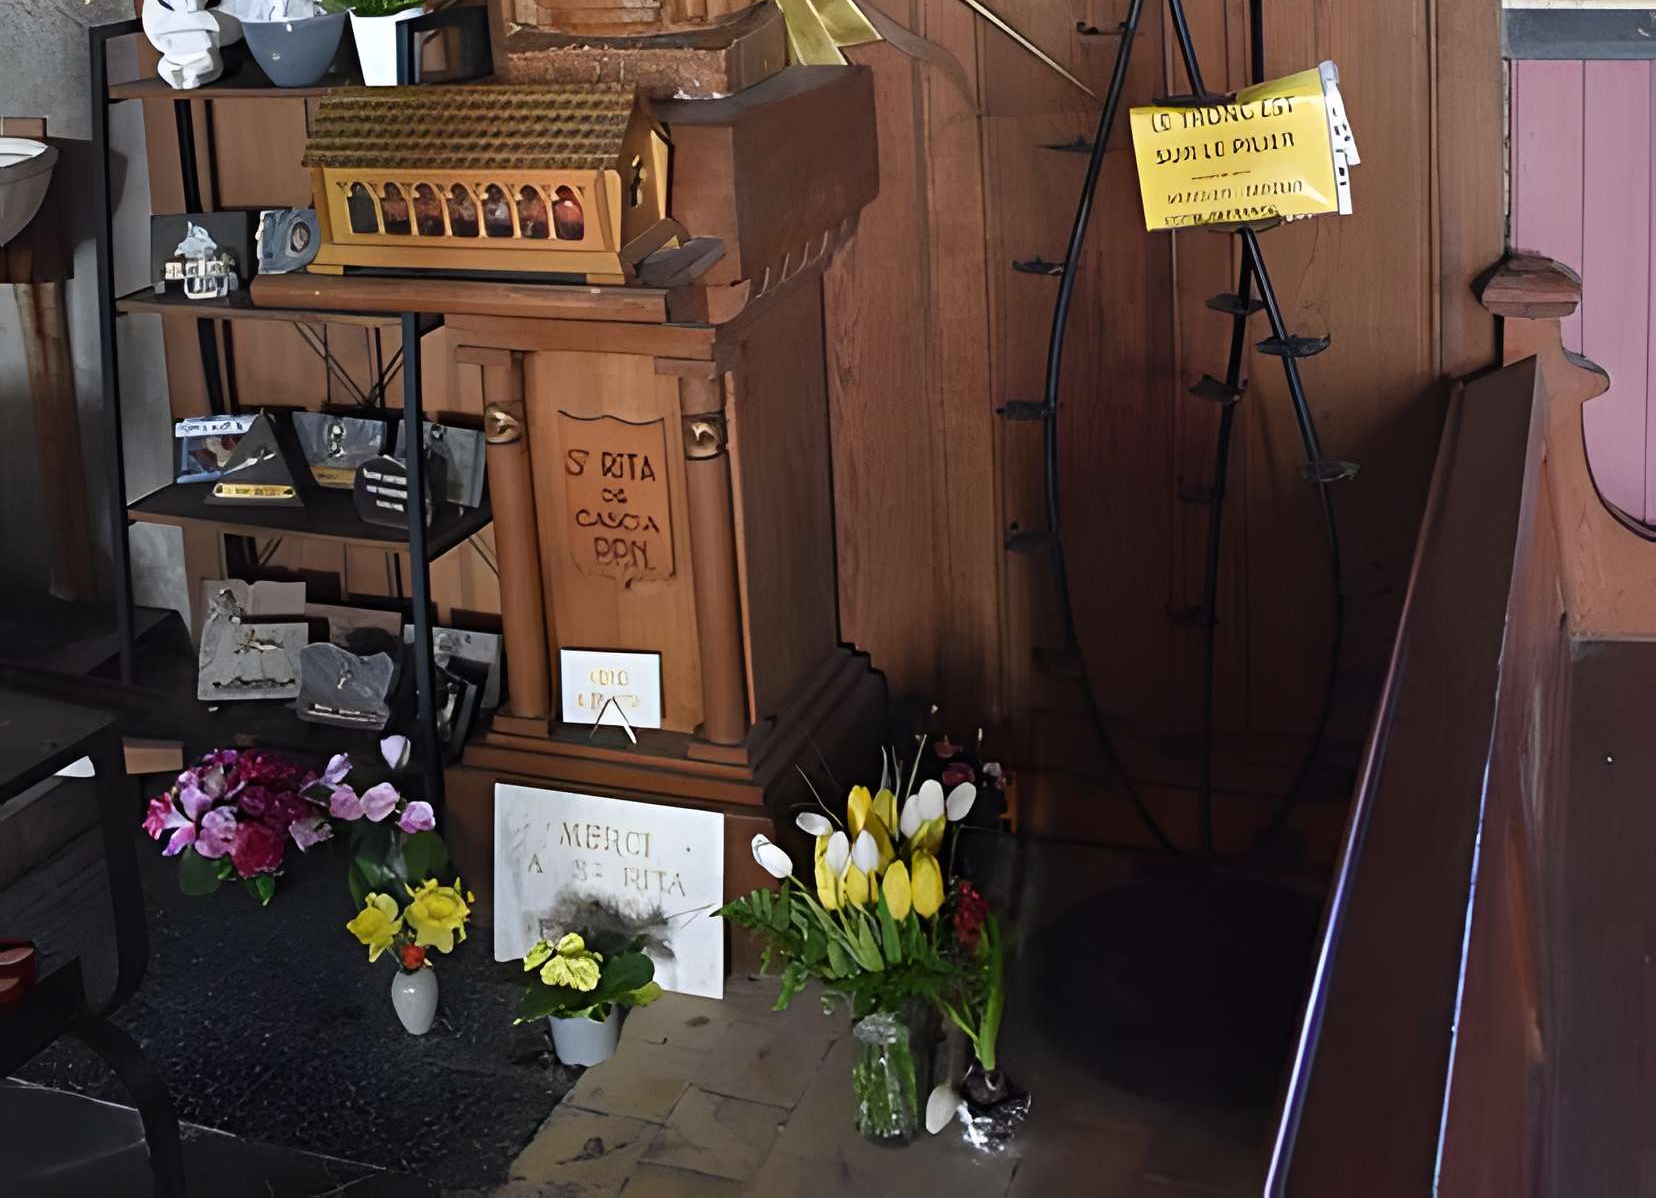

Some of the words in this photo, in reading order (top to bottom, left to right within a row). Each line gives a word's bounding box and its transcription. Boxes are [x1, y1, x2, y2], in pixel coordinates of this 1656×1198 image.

[601, 451, 656, 482] RITA
[560, 821, 652, 858] MERCI
[623, 866, 686, 897] RITA
